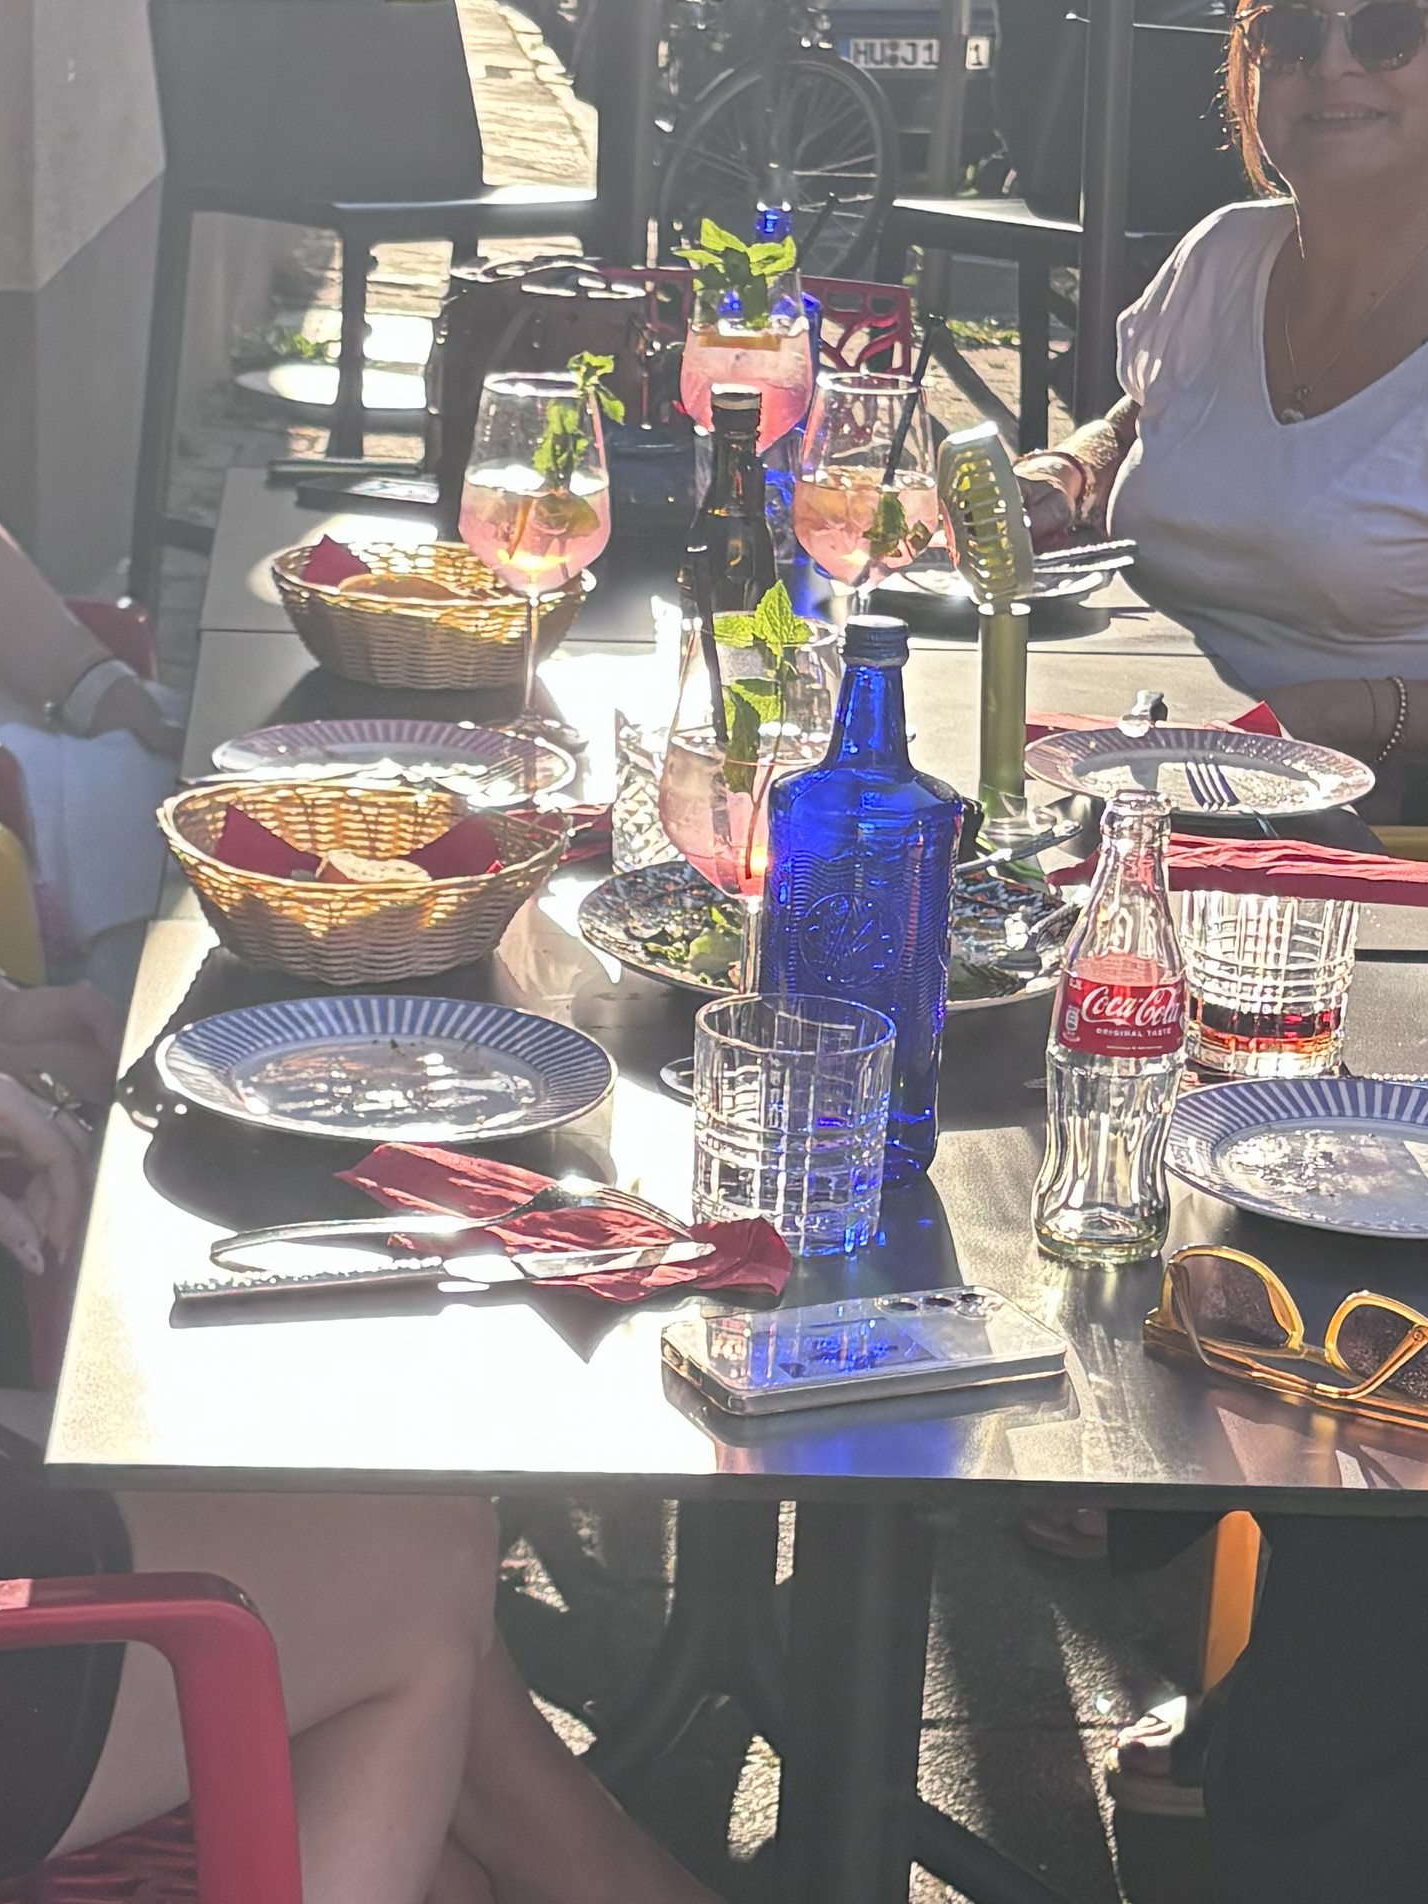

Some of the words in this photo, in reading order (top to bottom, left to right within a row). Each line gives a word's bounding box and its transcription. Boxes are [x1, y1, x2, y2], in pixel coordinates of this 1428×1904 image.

[853, 42, 885, 65] HU
[1080, 985, 1180, 1027] Coca-Cola
[1095, 1027, 1144, 1038] ORIGINAL
[1146, 1026, 1172, 1038] TASTE
